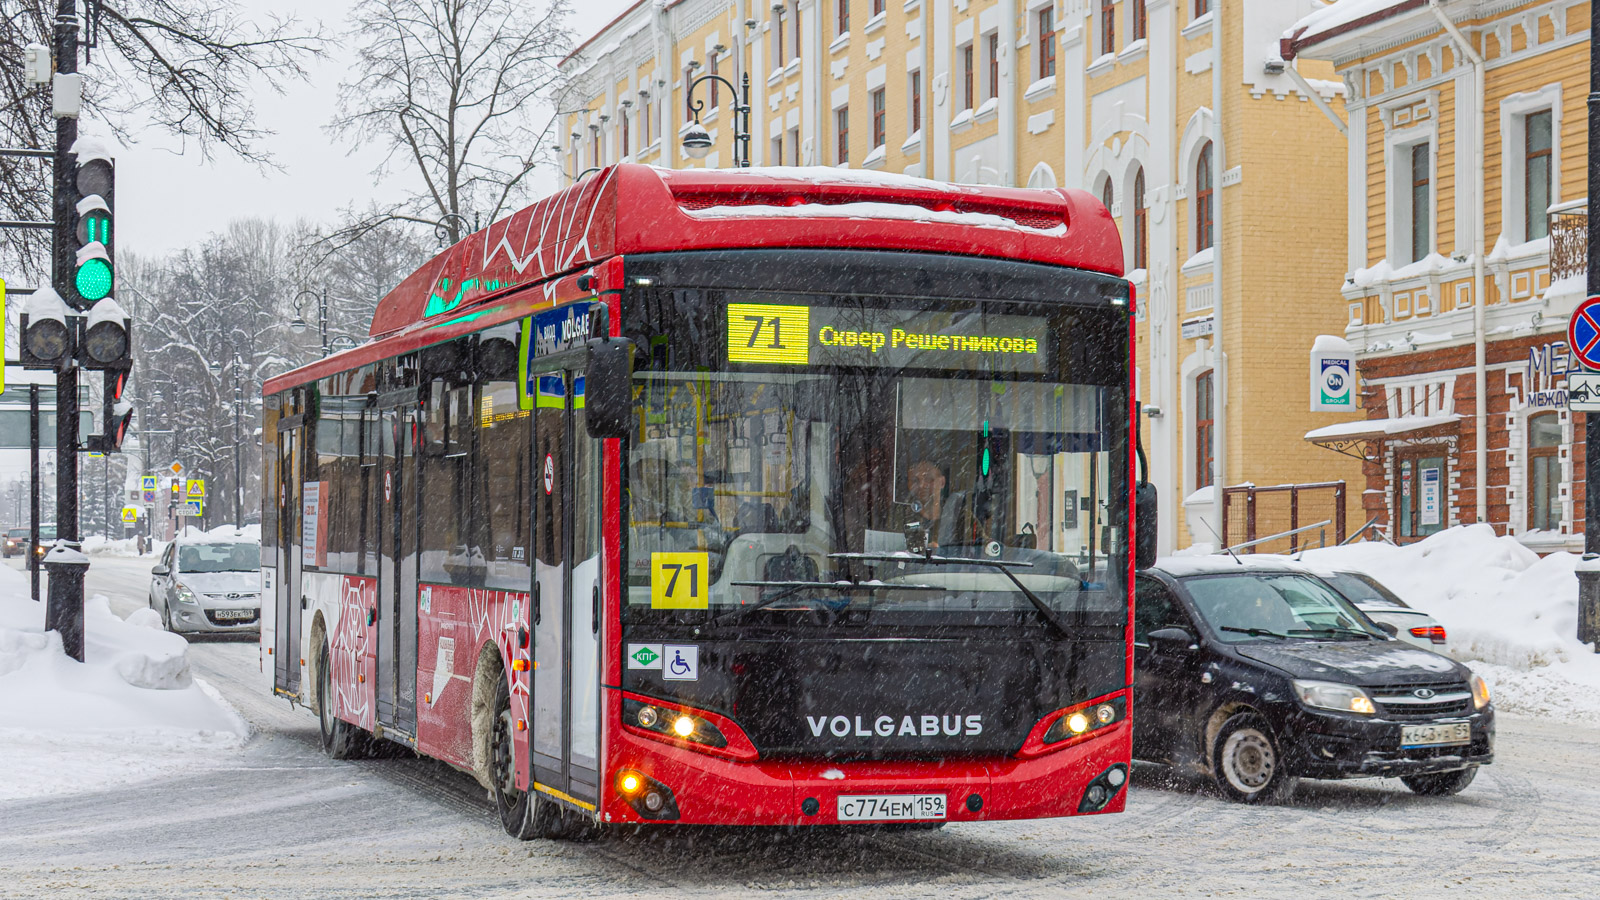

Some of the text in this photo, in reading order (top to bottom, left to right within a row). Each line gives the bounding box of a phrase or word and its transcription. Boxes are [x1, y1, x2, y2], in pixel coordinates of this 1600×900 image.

[744, 315, 786, 350] 71
[818, 325, 1038, 354] Сквер Решетникова
[1328, 374, 1342, 386] ON
[662, 563, 698, 598] 71
[636, 652, 655, 661] КПГ
[806, 715, 983, 737] VOLGABUS
[916, 796, 941, 811] 159
